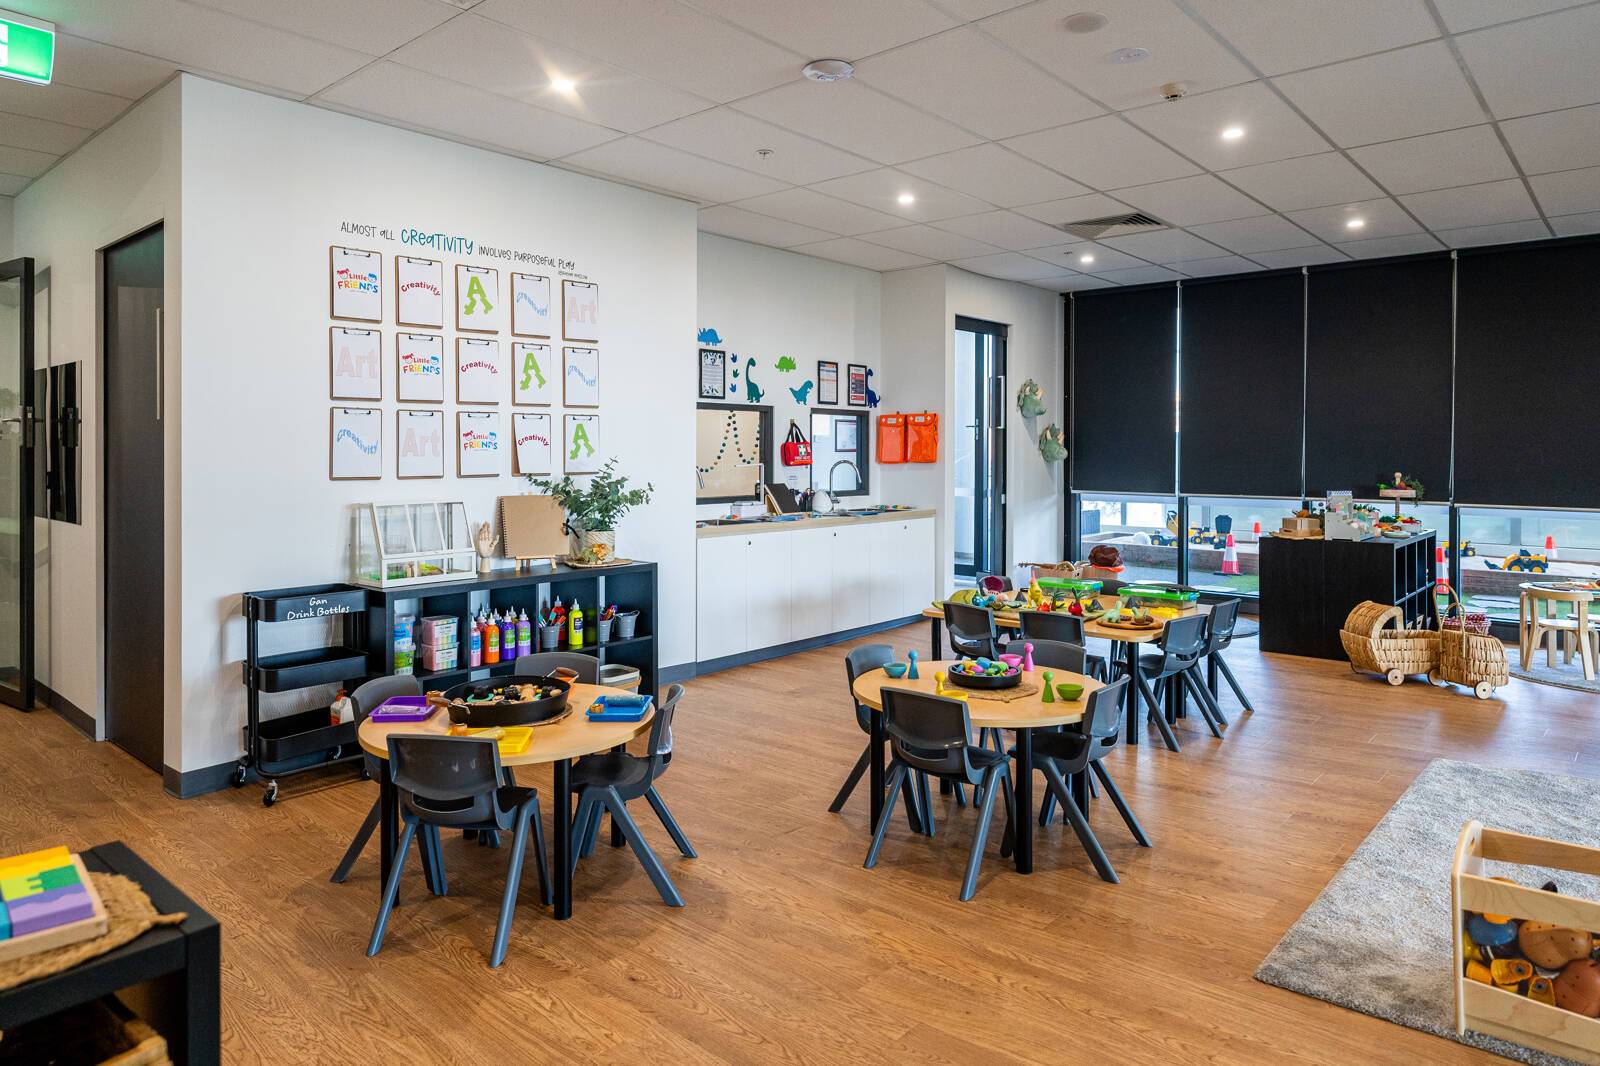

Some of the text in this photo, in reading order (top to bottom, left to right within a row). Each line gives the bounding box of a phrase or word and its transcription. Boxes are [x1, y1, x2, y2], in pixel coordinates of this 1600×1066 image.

[340, 221, 376, 238] ALMOST
[349, 273, 368, 282] Little
[401, 281, 441, 296] Creativity
[463, 275, 494, 316] A
[567, 297, 597, 324] Art
[335, 345, 379, 379] Art
[460, 359, 499, 375] Creativity
[519, 352, 546, 391] A
[402, 428, 441, 457] Art
[517, 434, 550, 447] Creativity
[569, 423, 596, 461] A
[309, 596, 328, 607] Gan
[287, 604, 350, 621] Drink Bottles
